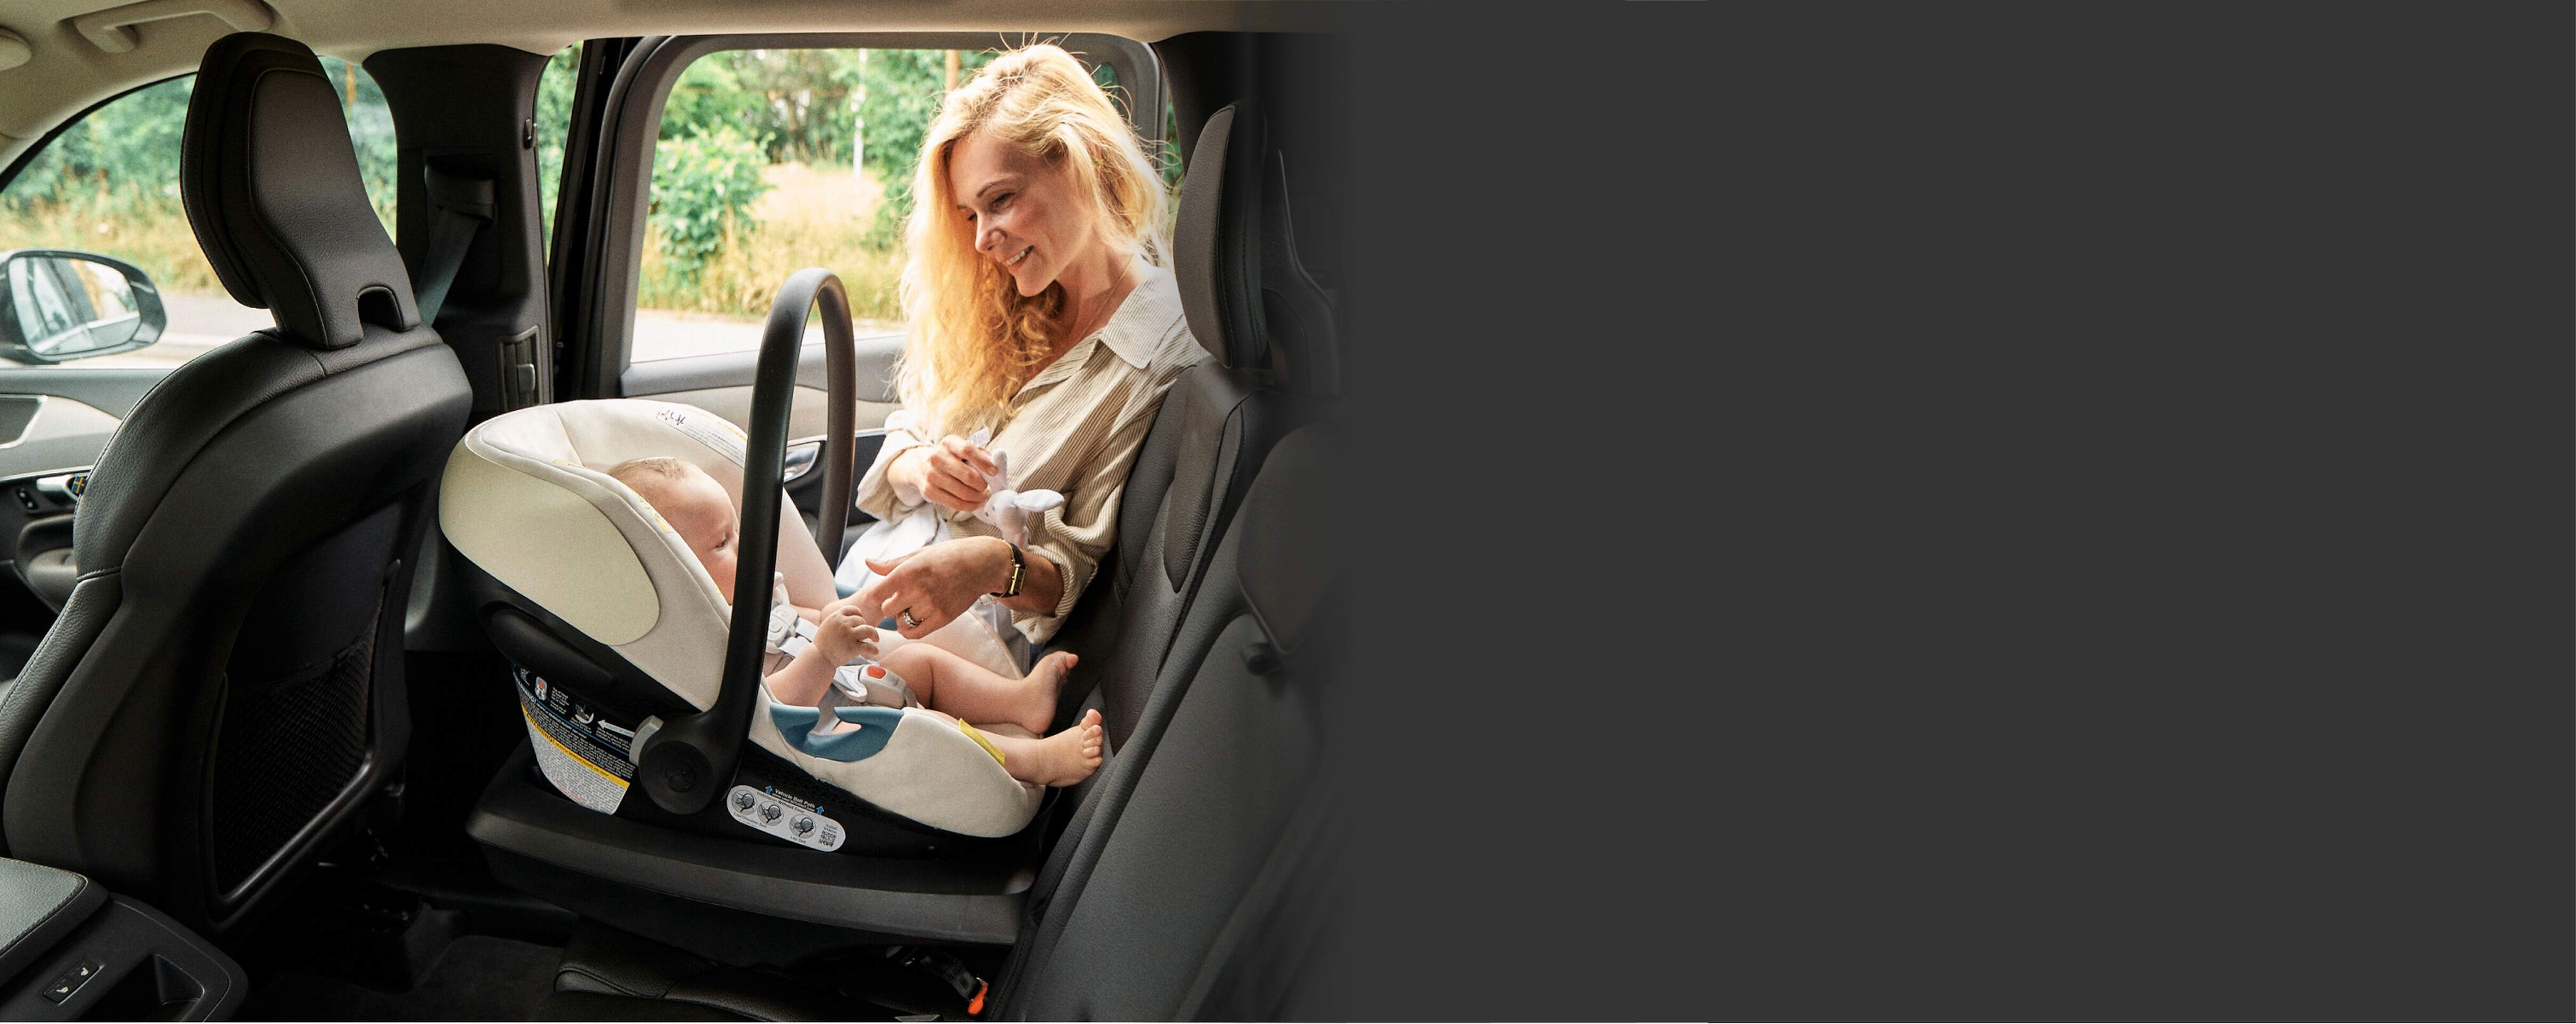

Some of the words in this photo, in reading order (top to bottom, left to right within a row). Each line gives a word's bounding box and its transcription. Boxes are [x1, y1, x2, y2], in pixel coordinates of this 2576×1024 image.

[775, 789, 793, 800] Vehicle
[793, 795, 804, 804] Belt
[804, 799, 815, 808] Path
[778, 799, 794, 810] Without
